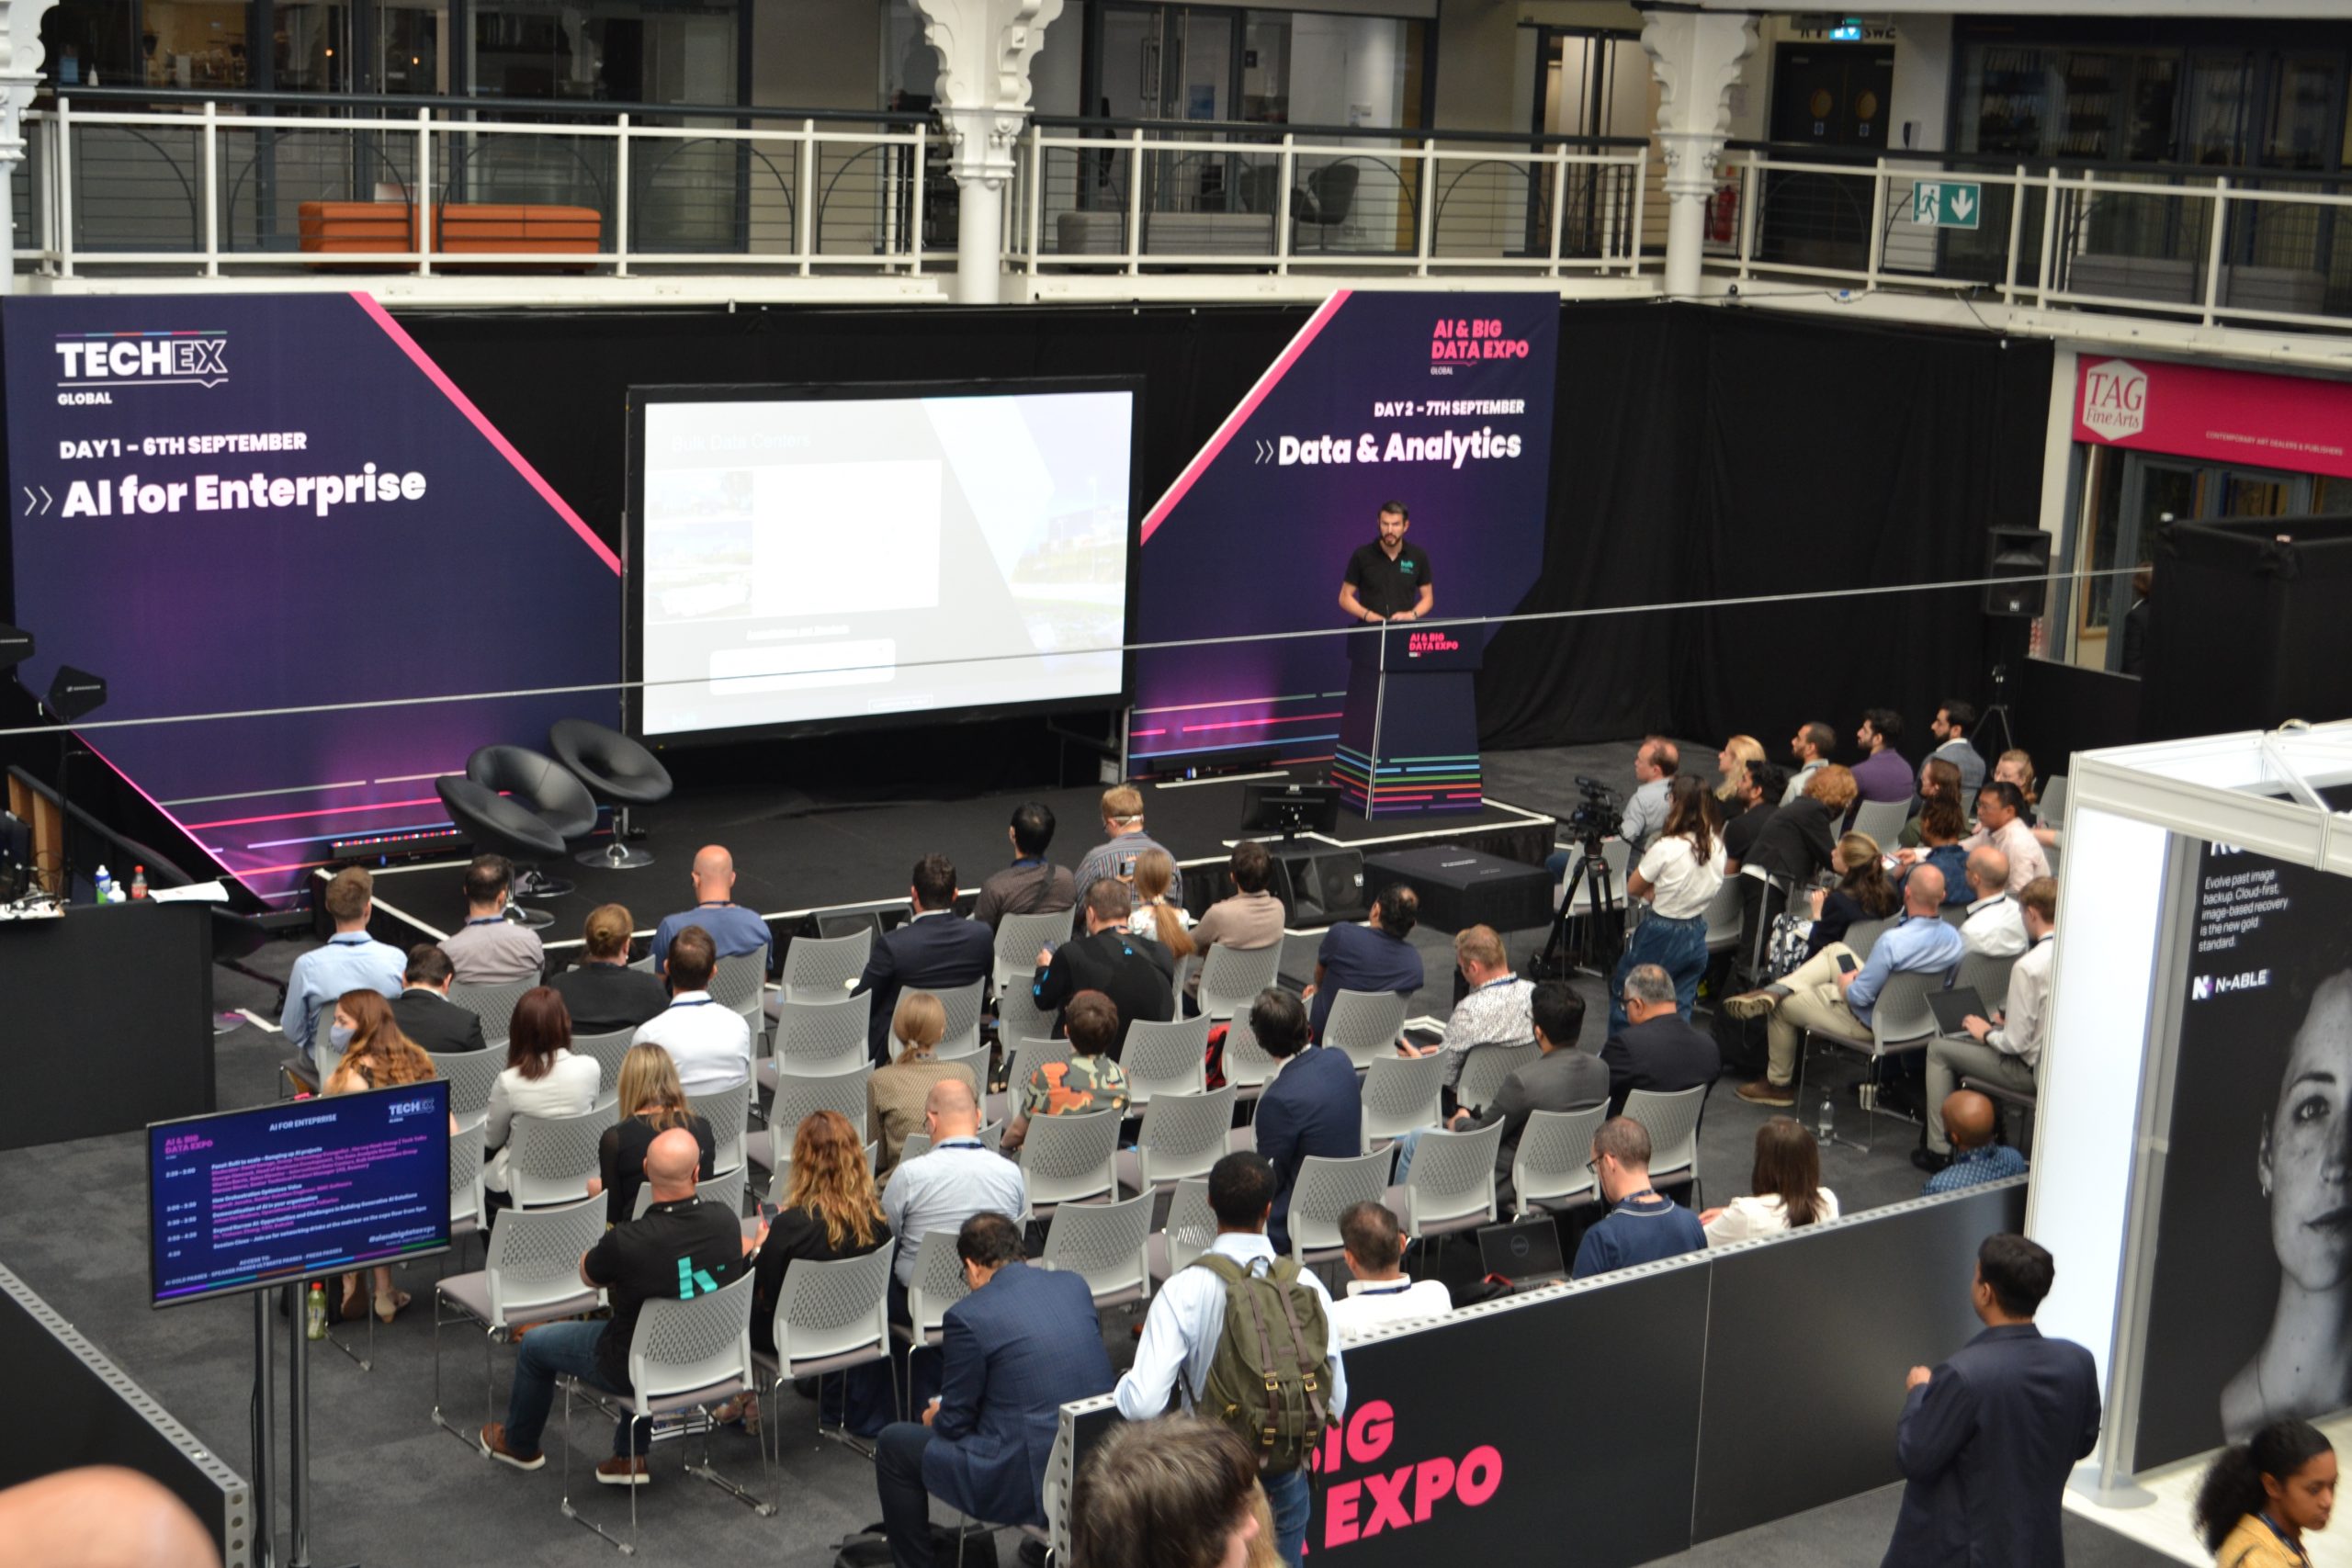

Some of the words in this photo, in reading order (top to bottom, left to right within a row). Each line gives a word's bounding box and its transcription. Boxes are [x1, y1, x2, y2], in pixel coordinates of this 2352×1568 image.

[1433, 320, 1453, 338] AI
[1455, 320, 1469, 337] &
[1472, 319, 1502, 338] BIG
[55, 340, 228, 378] TECHEX
[1430, 341, 1480, 360] DATA
[1482, 340, 1529, 358] EXPO
[1430, 367, 1453, 376] GLOBAL
[57, 391, 113, 406] GLOBAL
[2087, 372, 2145, 412] TAG
[1374, 401, 1404, 417] DAY
[1405, 401, 1413, 416] 2
[1427, 400, 1451, 416] 7TH
[1452, 399, 1525, 415] SEPTEMBER
[2086, 407, 2113, 425] Fine
[2113, 411, 2140, 429] Arts
[59, 439, 109, 459] DAY
[111, 439, 121, 457] 1
[143, 436, 186, 457] 6TH
[187, 432, 307, 455] SEPTEMBER
[1279, 435, 1351, 466] Data
[1356, 433, 1379, 462] &
[1383, 425, 1521, 468] Analytics
[2206, 430, 2256, 446] CONTEMPORARY
[2256, 437, 2270, 447] ART
[2269, 439, 2298, 451] DEALERS
[2304, 443, 2344, 457] PUBLISHERS
[61, 480, 111, 518] AI
[119, 475, 187, 515] for
[195, 462, 427, 517] Enterprise
[1409, 641, 1433, 651] DATA
[1434, 640, 1459, 650] EXPO
[1410, 632, 1421, 641] AI
[1429, 632, 1445, 641] BIG
[2205, 876, 2231, 890] Evolve
[2232, 874, 2250, 887] past
[2250, 869, 2276, 885] image
[2201, 901, 2254, 922] image-based
[2254, 897, 2289, 912] recovery
[2200, 924, 2207, 936] is
[2208, 921, 2222, 935] the
[2223, 921, 2240, 932] new
[2241, 917, 2259, 933] gold
[2198, 935, 2236, 953] standard.
[2215, 968, 2270, 993] N-ABLE
[278, 1120, 293, 1130] FOR
[164, 1143, 189, 1154] DATA
[1312, 1400, 1394, 1473] IG
[1324, 1445, 1503, 1550] EXPO
